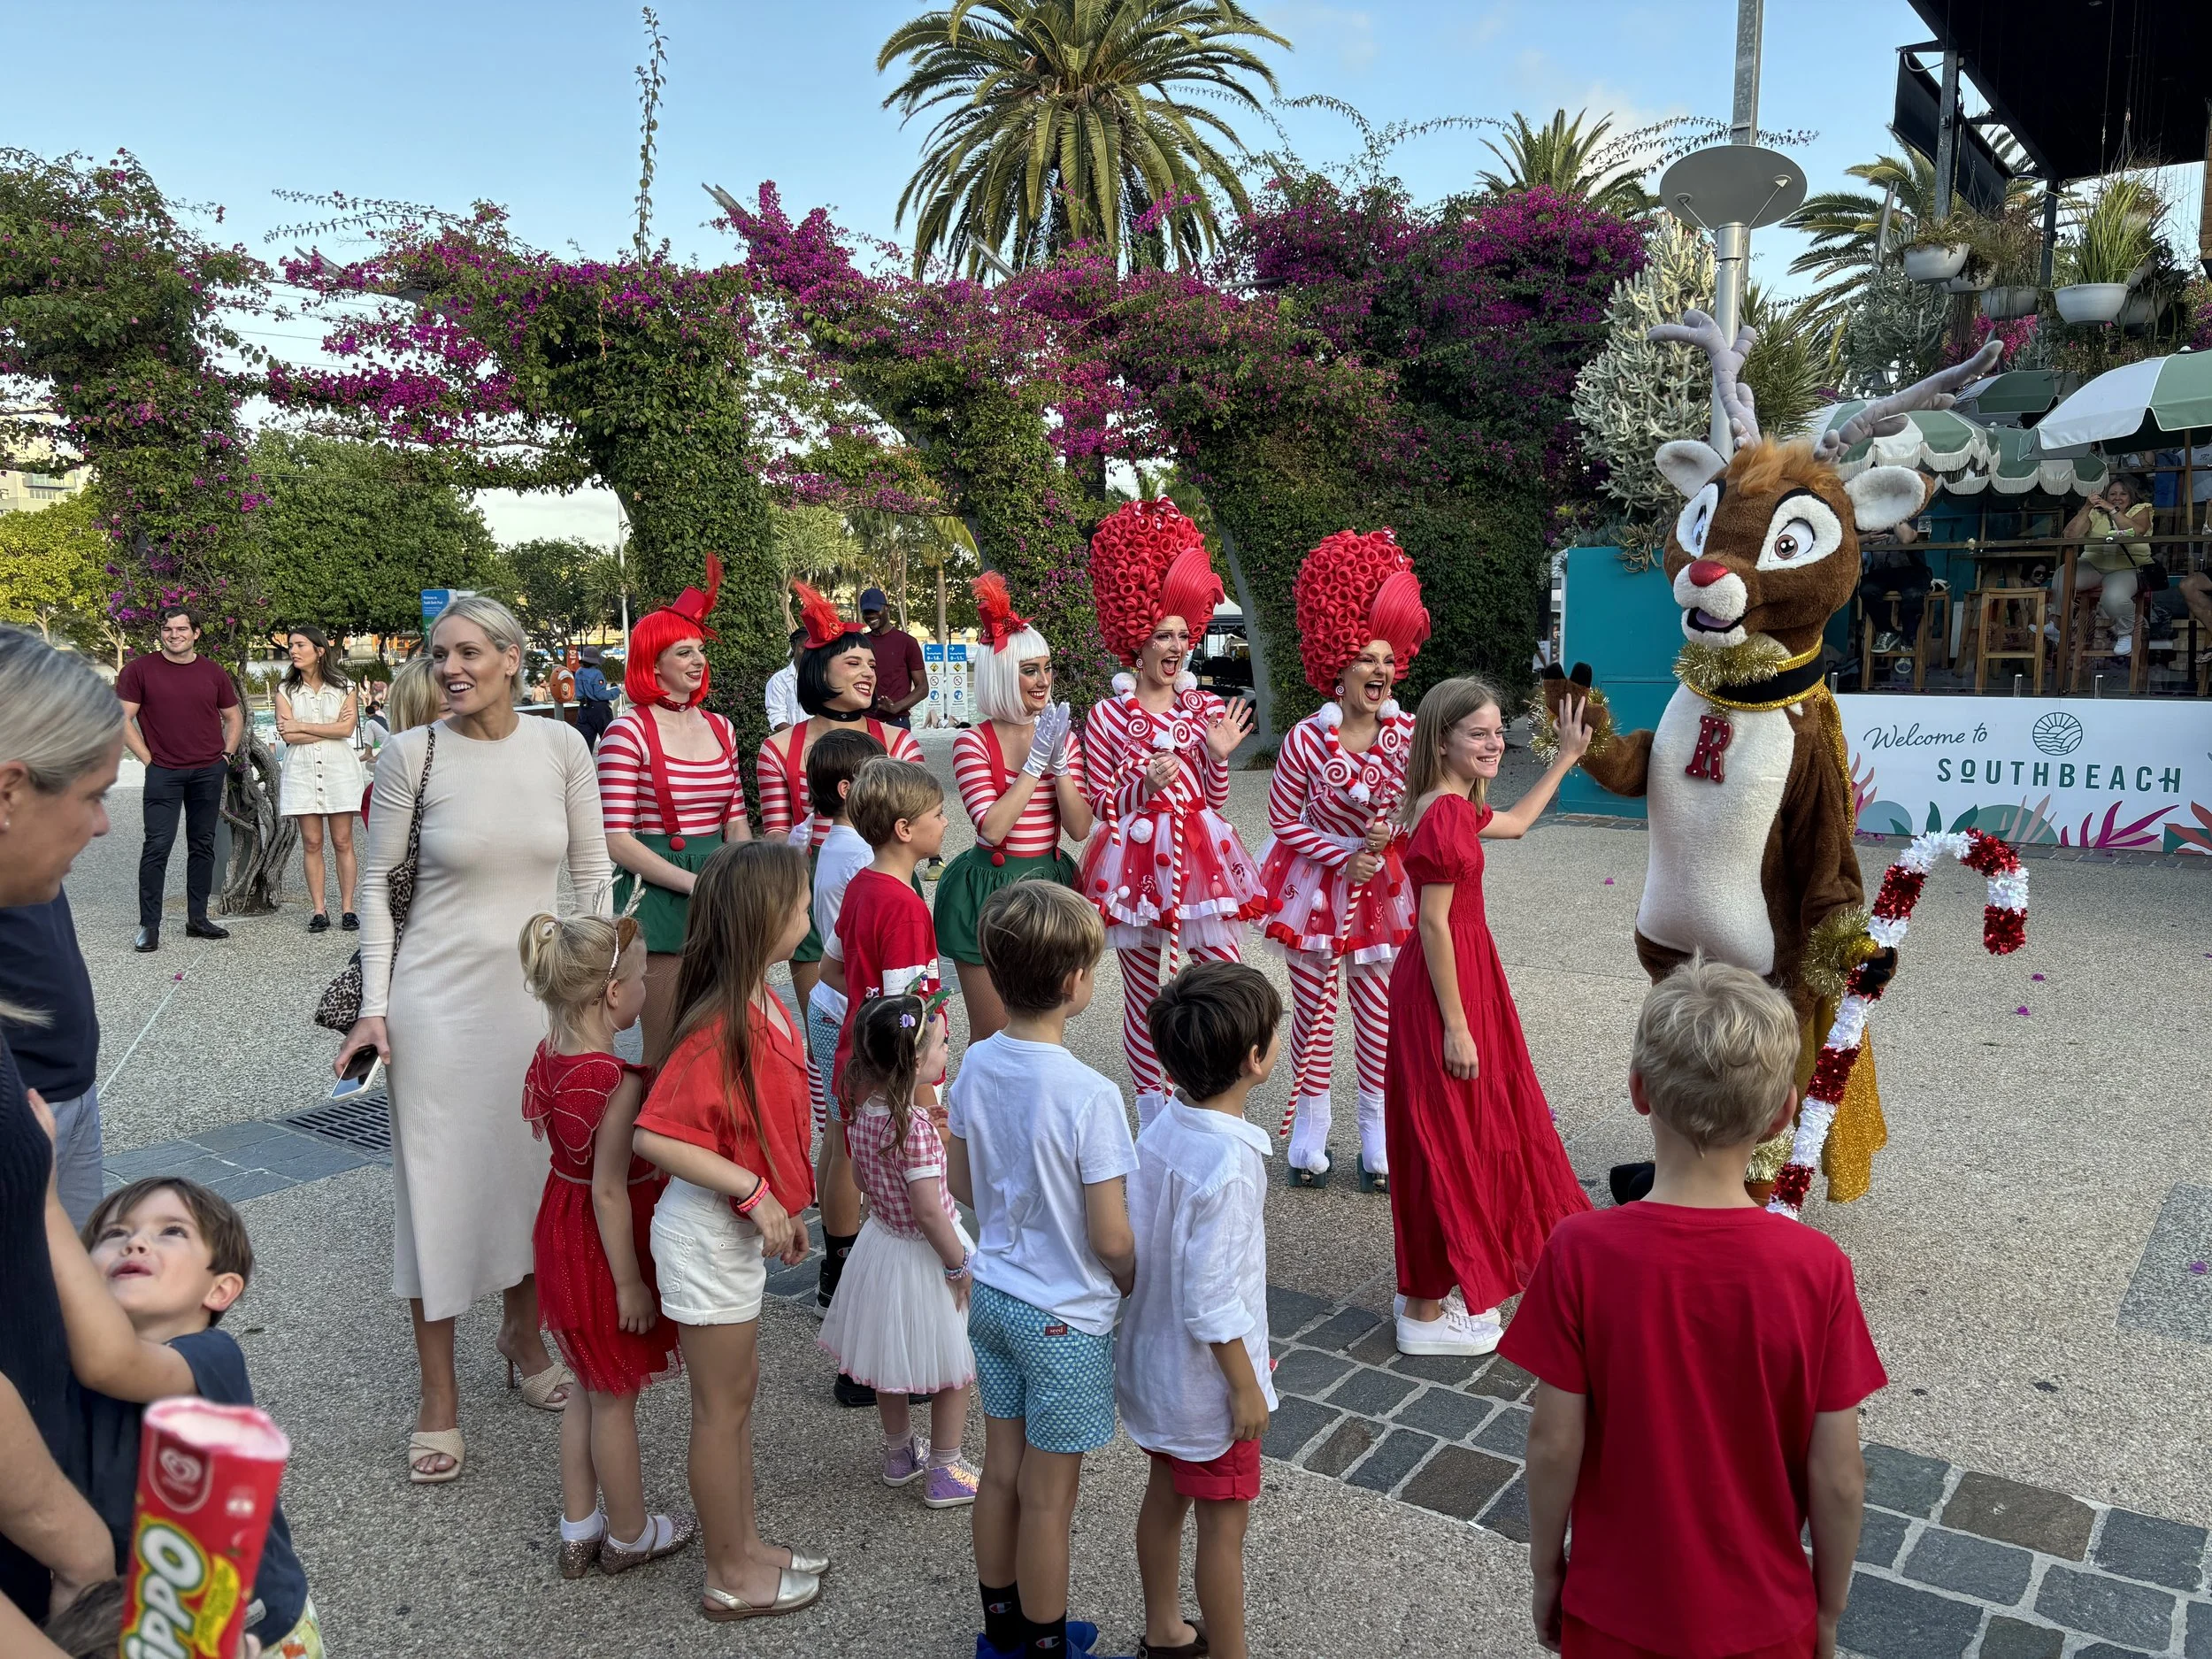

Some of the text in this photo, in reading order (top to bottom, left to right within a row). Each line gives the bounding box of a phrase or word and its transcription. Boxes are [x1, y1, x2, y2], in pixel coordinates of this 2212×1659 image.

[1685, 715, 1733, 783] R
[1863, 722, 1988, 750] Welcome to
[1937, 758, 2182, 794] SOUTHBEACH
